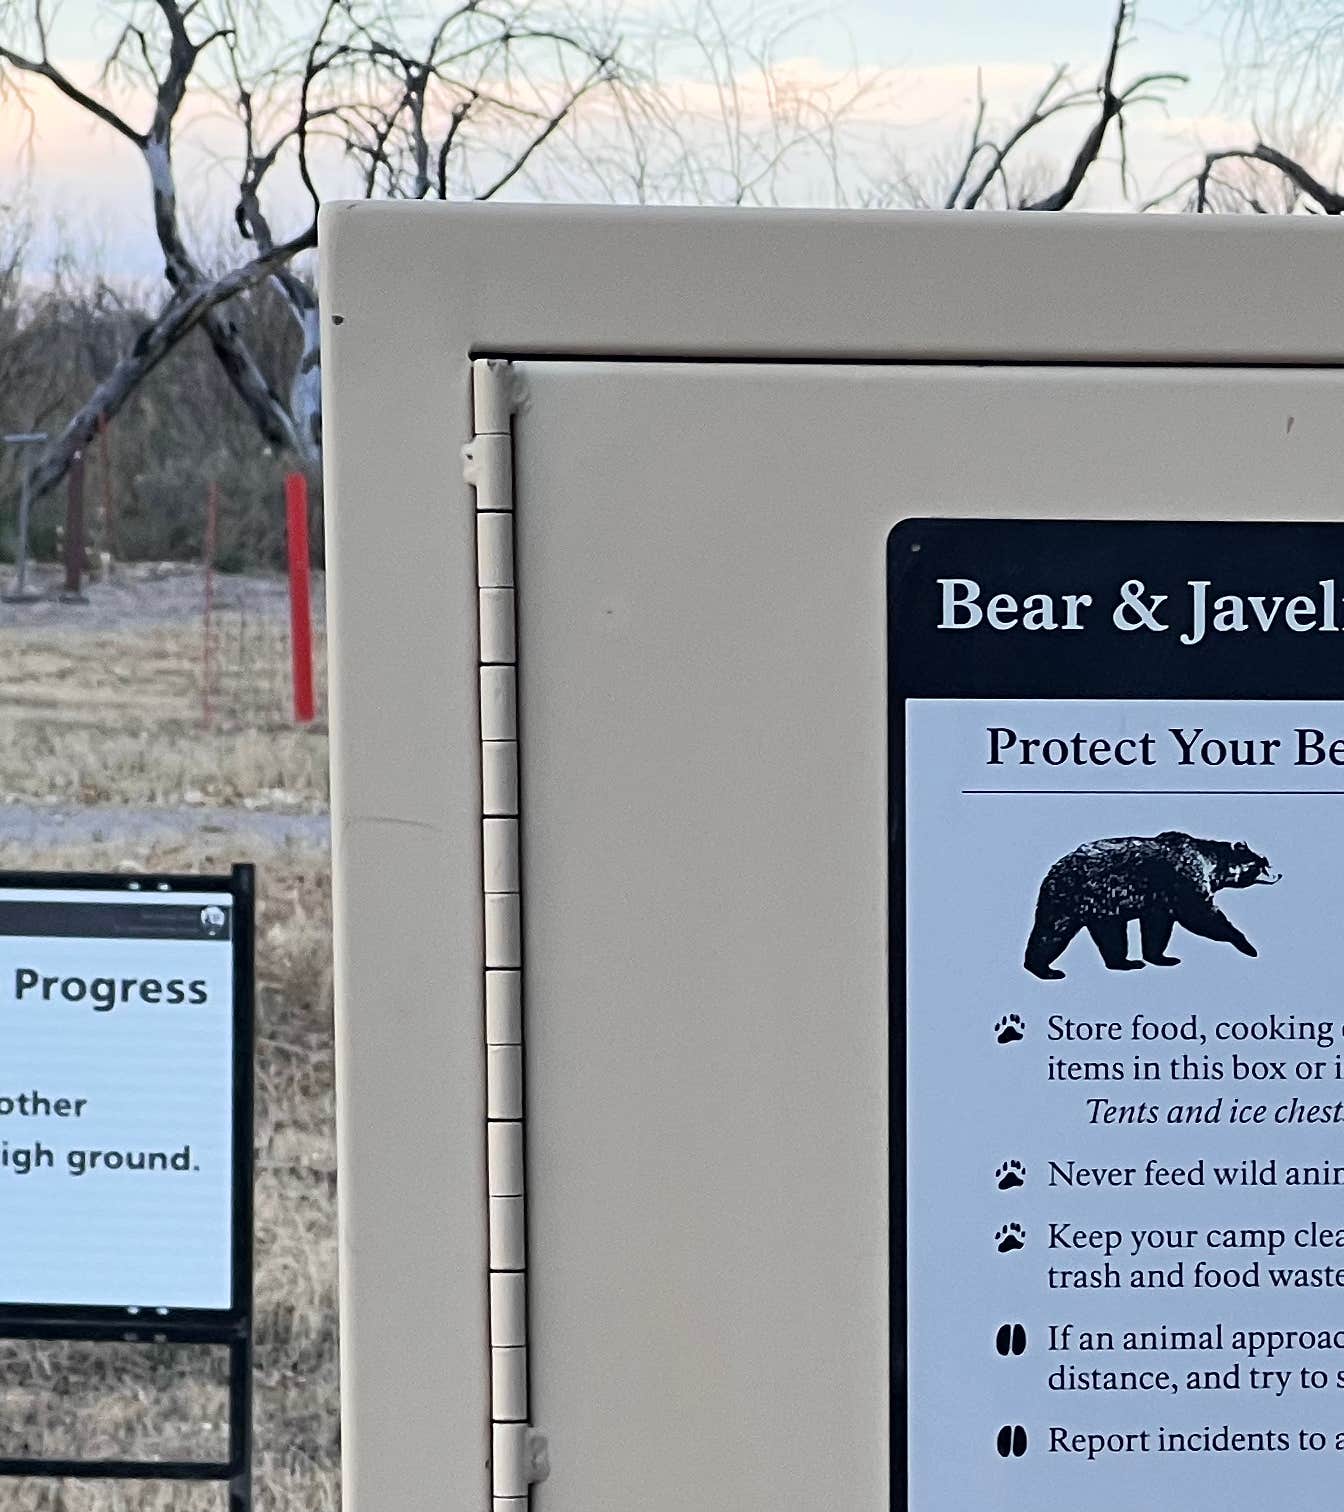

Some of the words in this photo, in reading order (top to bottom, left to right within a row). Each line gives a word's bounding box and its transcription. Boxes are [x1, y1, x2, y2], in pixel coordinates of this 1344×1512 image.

[937, 579, 1092, 630] Bear
[1113, 580, 1169, 631] &
[987, 728, 1156, 765] Protect
[1168, 729, 1280, 765] Your
[16, 969, 207, 1012] Progress
[1048, 1015, 1122, 1040] Store
[1132, 1015, 1206, 1045] food,
[1216, 1015, 1333, 1048] cooking
[1048, 1056, 1124, 1080] items
[1134, 1056, 1160, 1080] in
[1171, 1055, 1223, 1080] this
[1232, 1054, 1287, 1079] box
[1296, 1062, 1326, 1079] or
[1087, 1099, 1159, 1123] Tents
[1167, 1098, 1222, 1123] and
[1230, 1099, 1266, 1123] ice
[67, 1145, 199, 1176] ground.
[1048, 1161, 1136, 1186] Never
[1144, 1160, 1204, 1185] feed
[1214, 1160, 1277, 1185] wild
[1048, 1224, 1122, 1256] Keep
[1131, 1231, 1198, 1256] your
[1207, 1230, 1285, 1255] camp
[1048, 1263, 1121, 1288] trash
[1131, 1262, 1184, 1287] and
[1194, 1262, 1259, 1287] food
[1048, 1325, 1073, 1350] If
[1080, 1333, 1114, 1350] an
[1124, 1324, 1223, 1350] animal
[1049, 1365, 1177, 1394] distance,
[1187, 1364, 1240, 1389] and
[1250, 1368, 1292, 1396] try
[1301, 1368, 1327, 1388] to
[1049, 1428, 1150, 1460] Report
[1158, 1426, 1289, 1451] incidents
[1299, 1430, 1326, 1450] to
